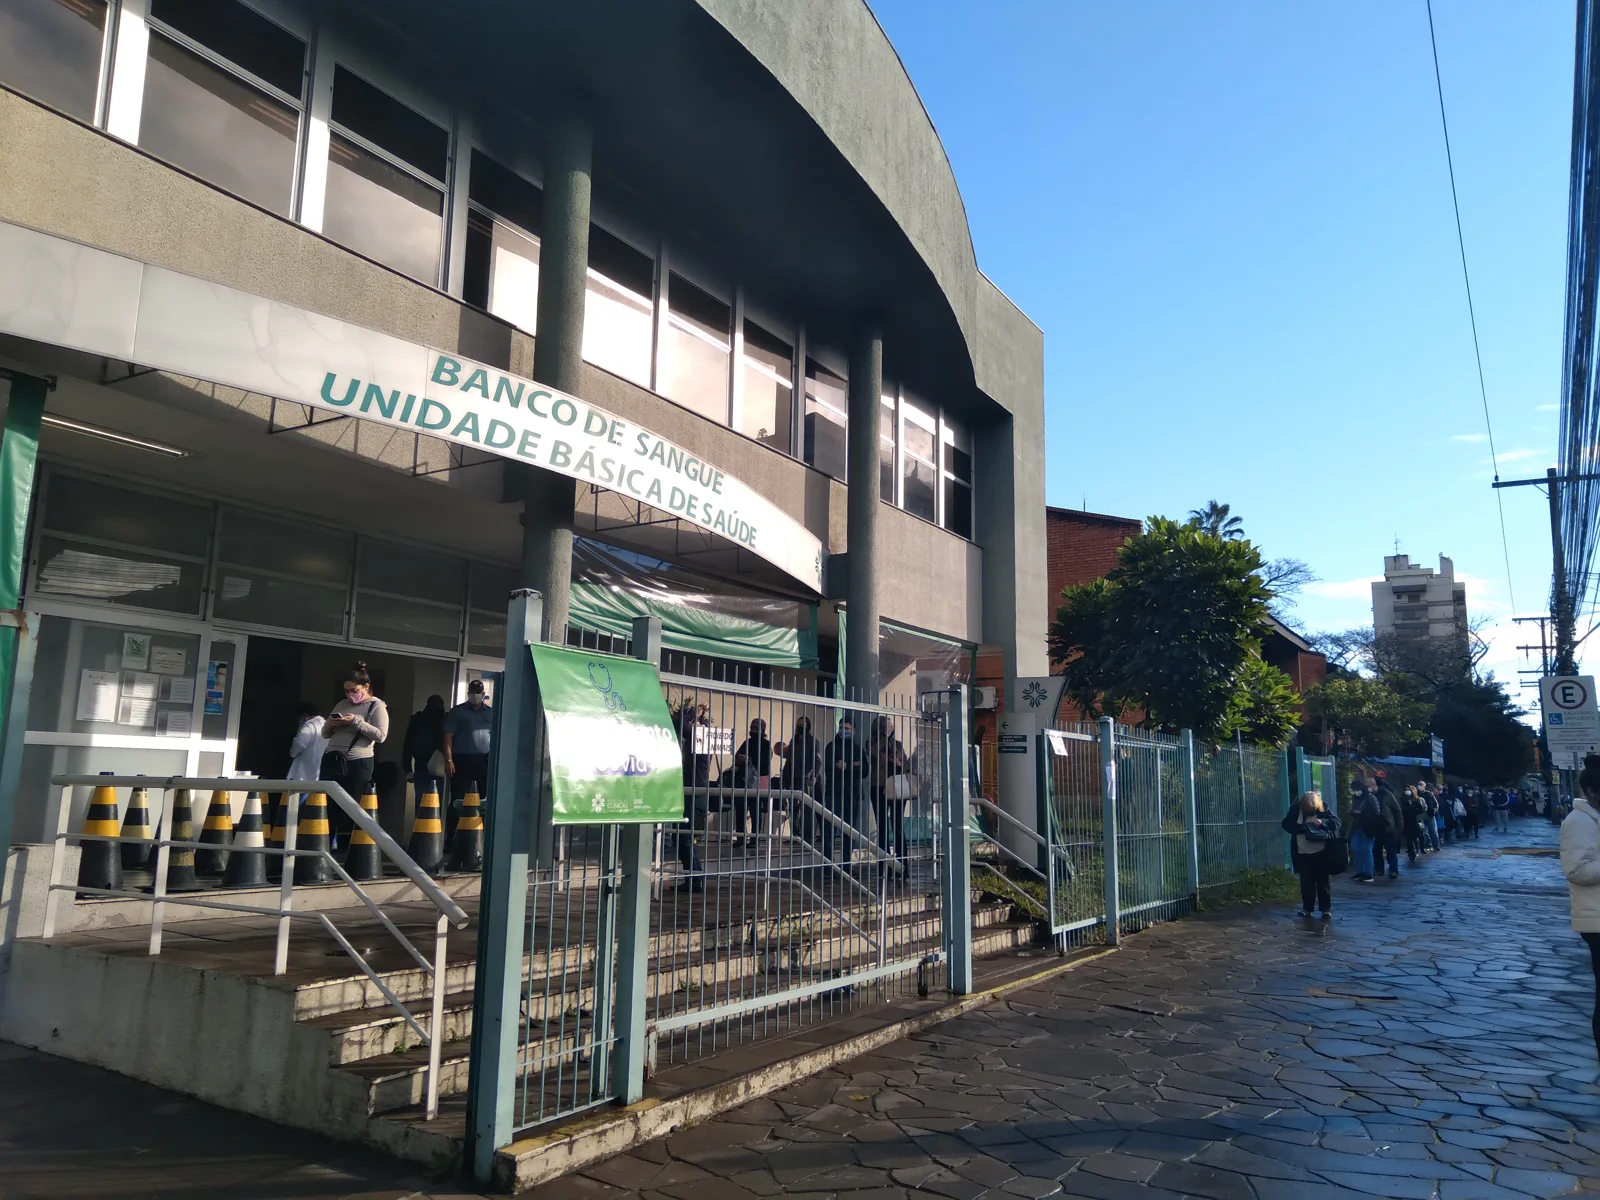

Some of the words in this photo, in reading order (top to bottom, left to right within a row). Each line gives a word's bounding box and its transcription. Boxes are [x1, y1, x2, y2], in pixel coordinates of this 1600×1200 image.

[319, 371, 542, 460] UNIDADE
[548, 439, 662, 504] BÁSICA
[668, 486, 705, 519] DE
[701, 503, 758, 549] SAÚDE
[430, 355, 578, 427] BANCO
[583, 409, 626, 447] DE
[634, 432, 728, 495] SANGUE
[1562, 686, 1575, 703] E
